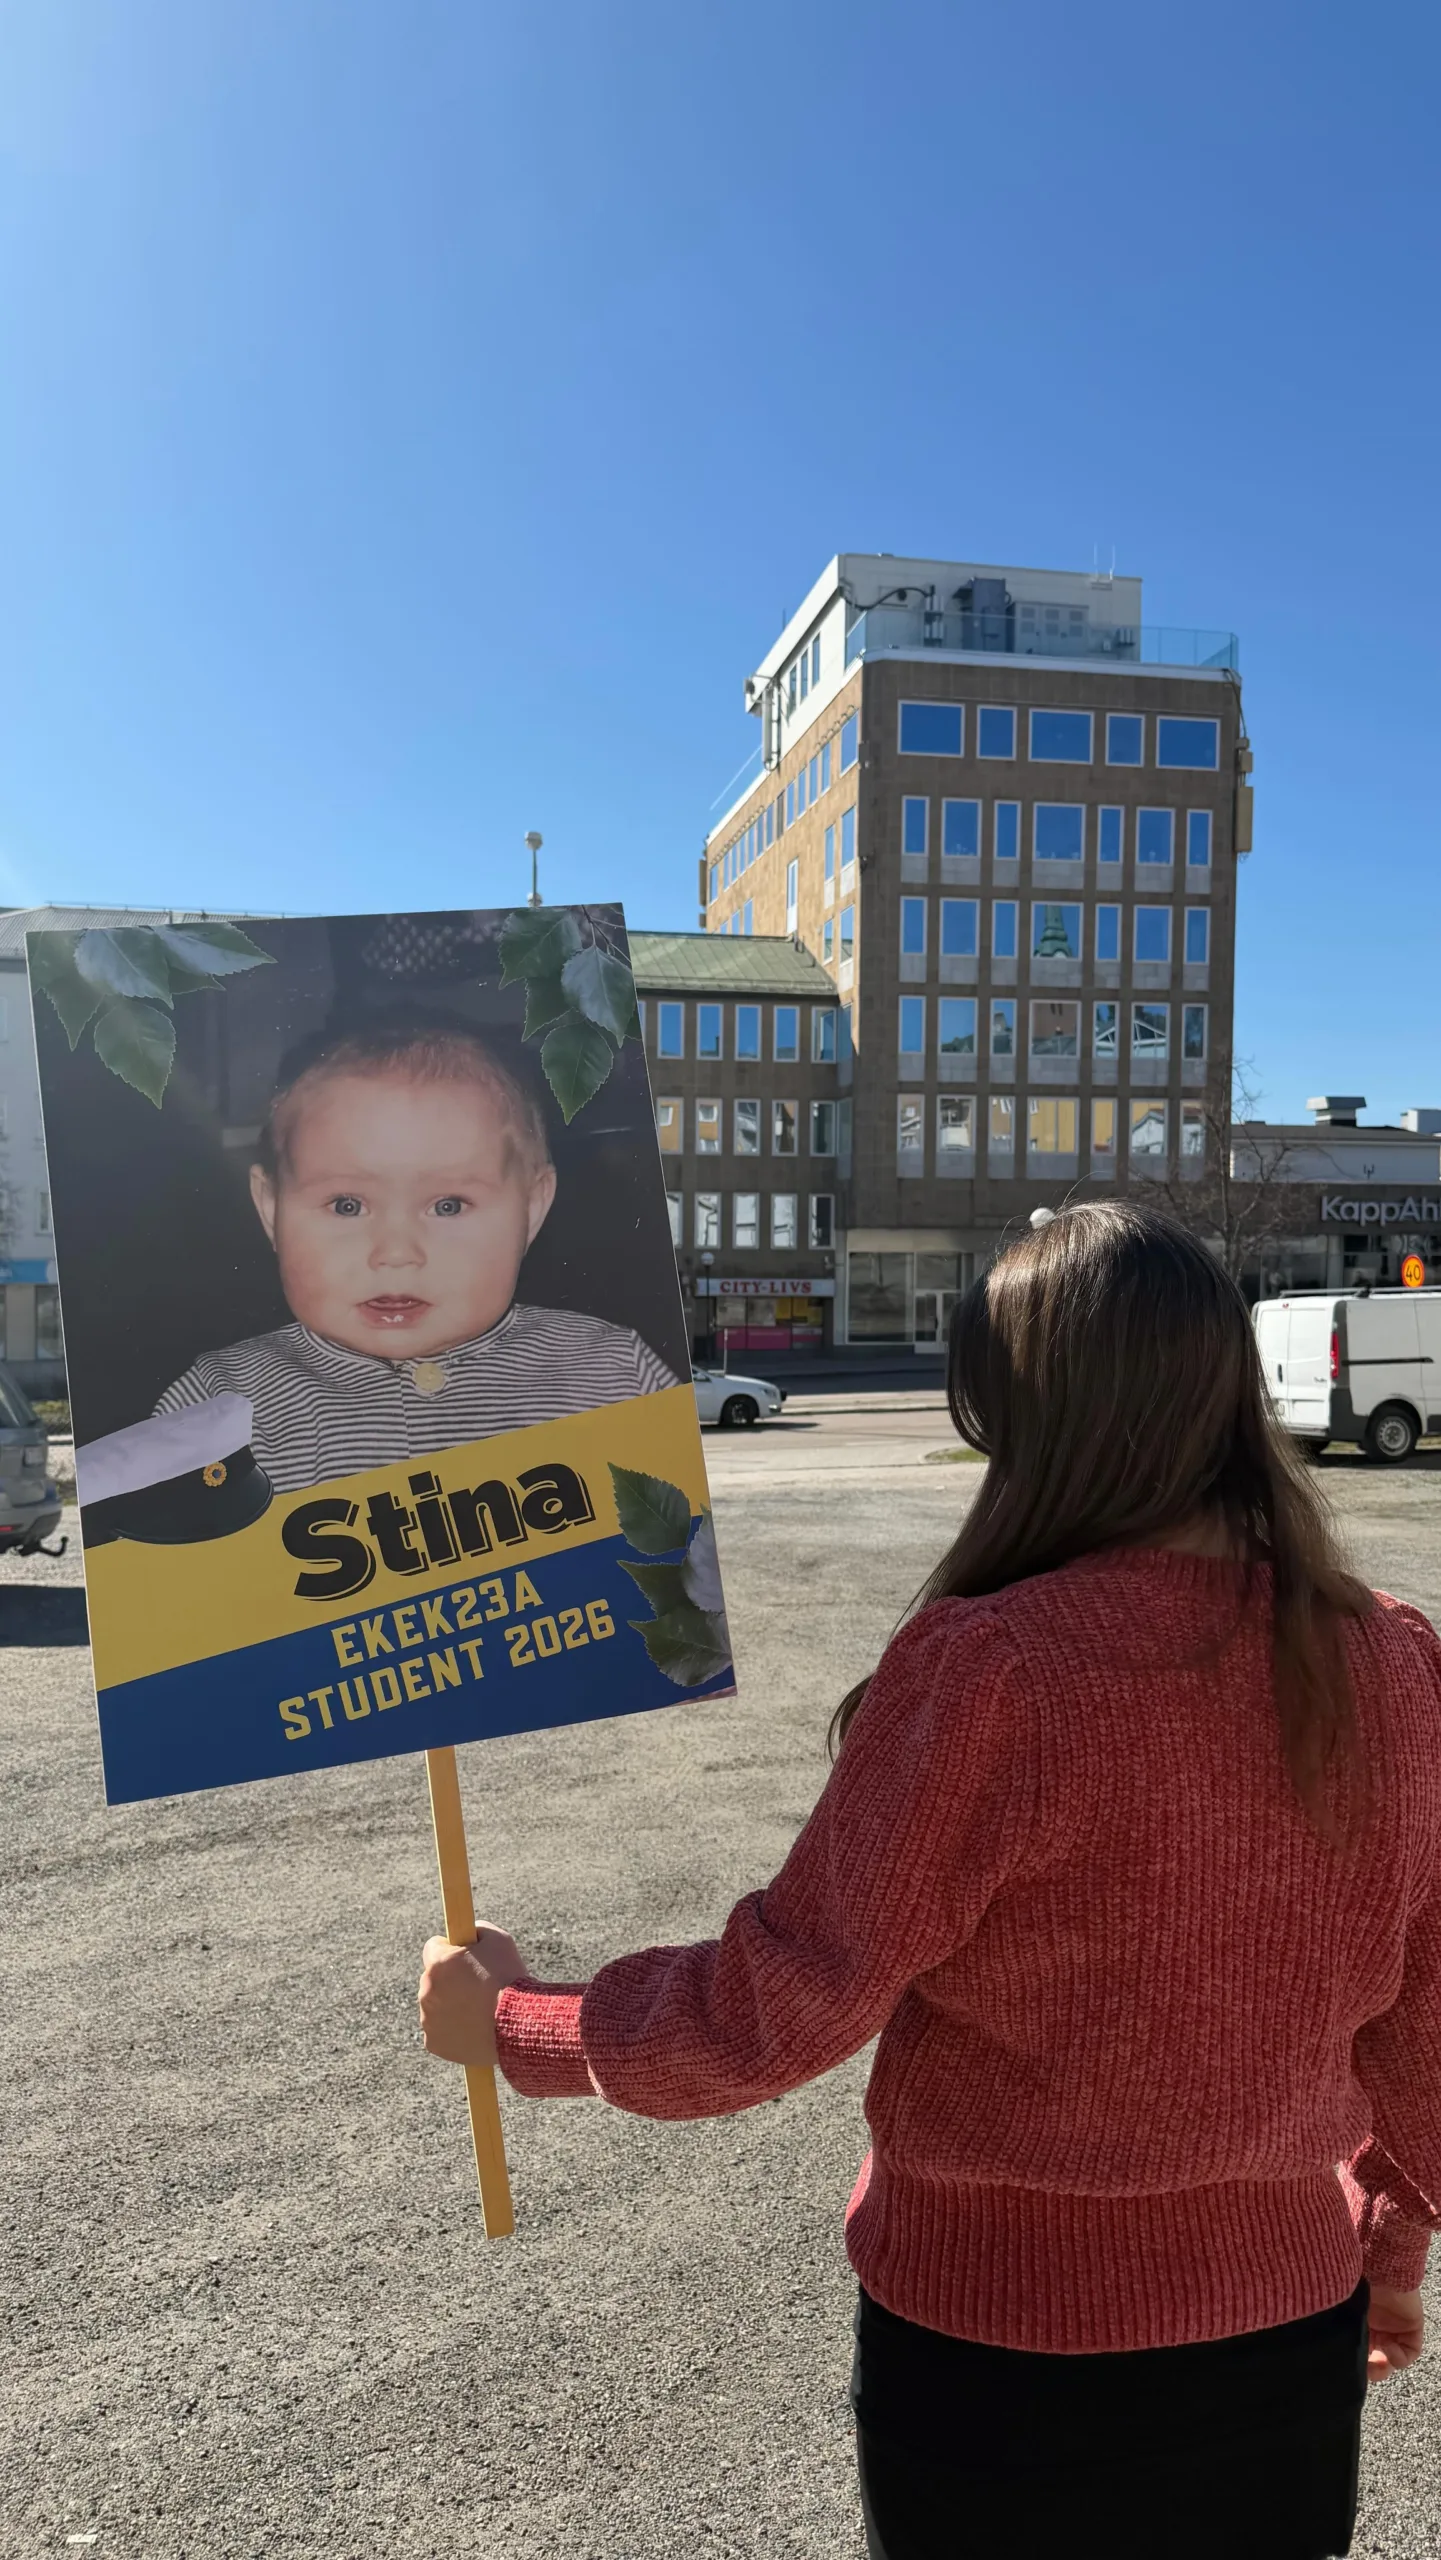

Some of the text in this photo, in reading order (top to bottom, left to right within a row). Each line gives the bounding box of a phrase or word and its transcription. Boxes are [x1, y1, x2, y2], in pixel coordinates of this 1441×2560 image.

[719, 1281, 812, 1294] CITY-LIVS
[1405, 1264, 1421, 1282] 40
[281, 1463, 596, 1602] Stina
[331, 1570, 544, 1669] EKEK23A
[278, 1598, 616, 1741] STUDENT 2026
